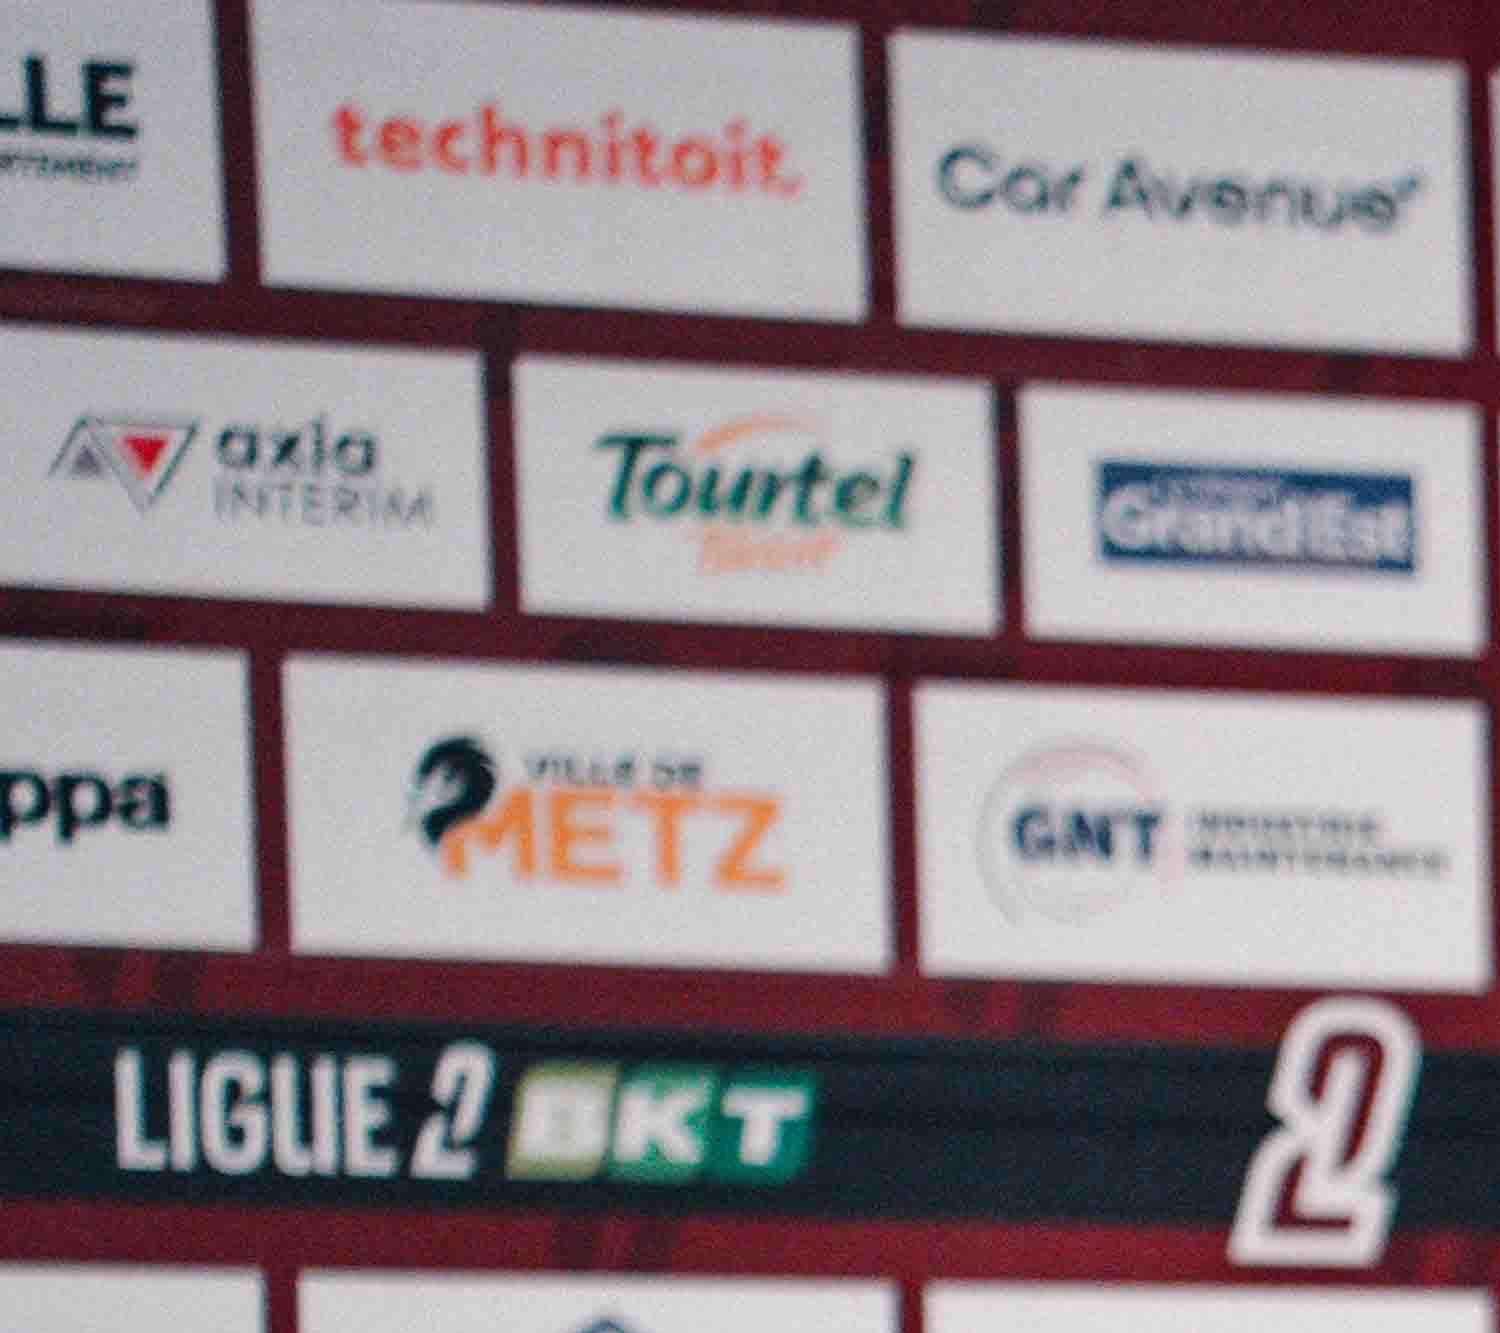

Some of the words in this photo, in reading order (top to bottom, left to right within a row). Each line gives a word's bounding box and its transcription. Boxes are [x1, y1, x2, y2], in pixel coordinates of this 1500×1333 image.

[330, 102, 797, 193] technitoit.
[935, 143, 1085, 214] Car
[215, 420, 377, 477] axia
[590, 430, 920, 530] Tourtel
[214, 478, 432, 525] INTERIM
[435, 786, 788, 894] METZ
[1011, 806, 1162, 861] GNT
[116, 1052, 394, 1174] LIGUE
[412, 1046, 491, 1177] 2
[512, 1072, 808, 1168] BKT
